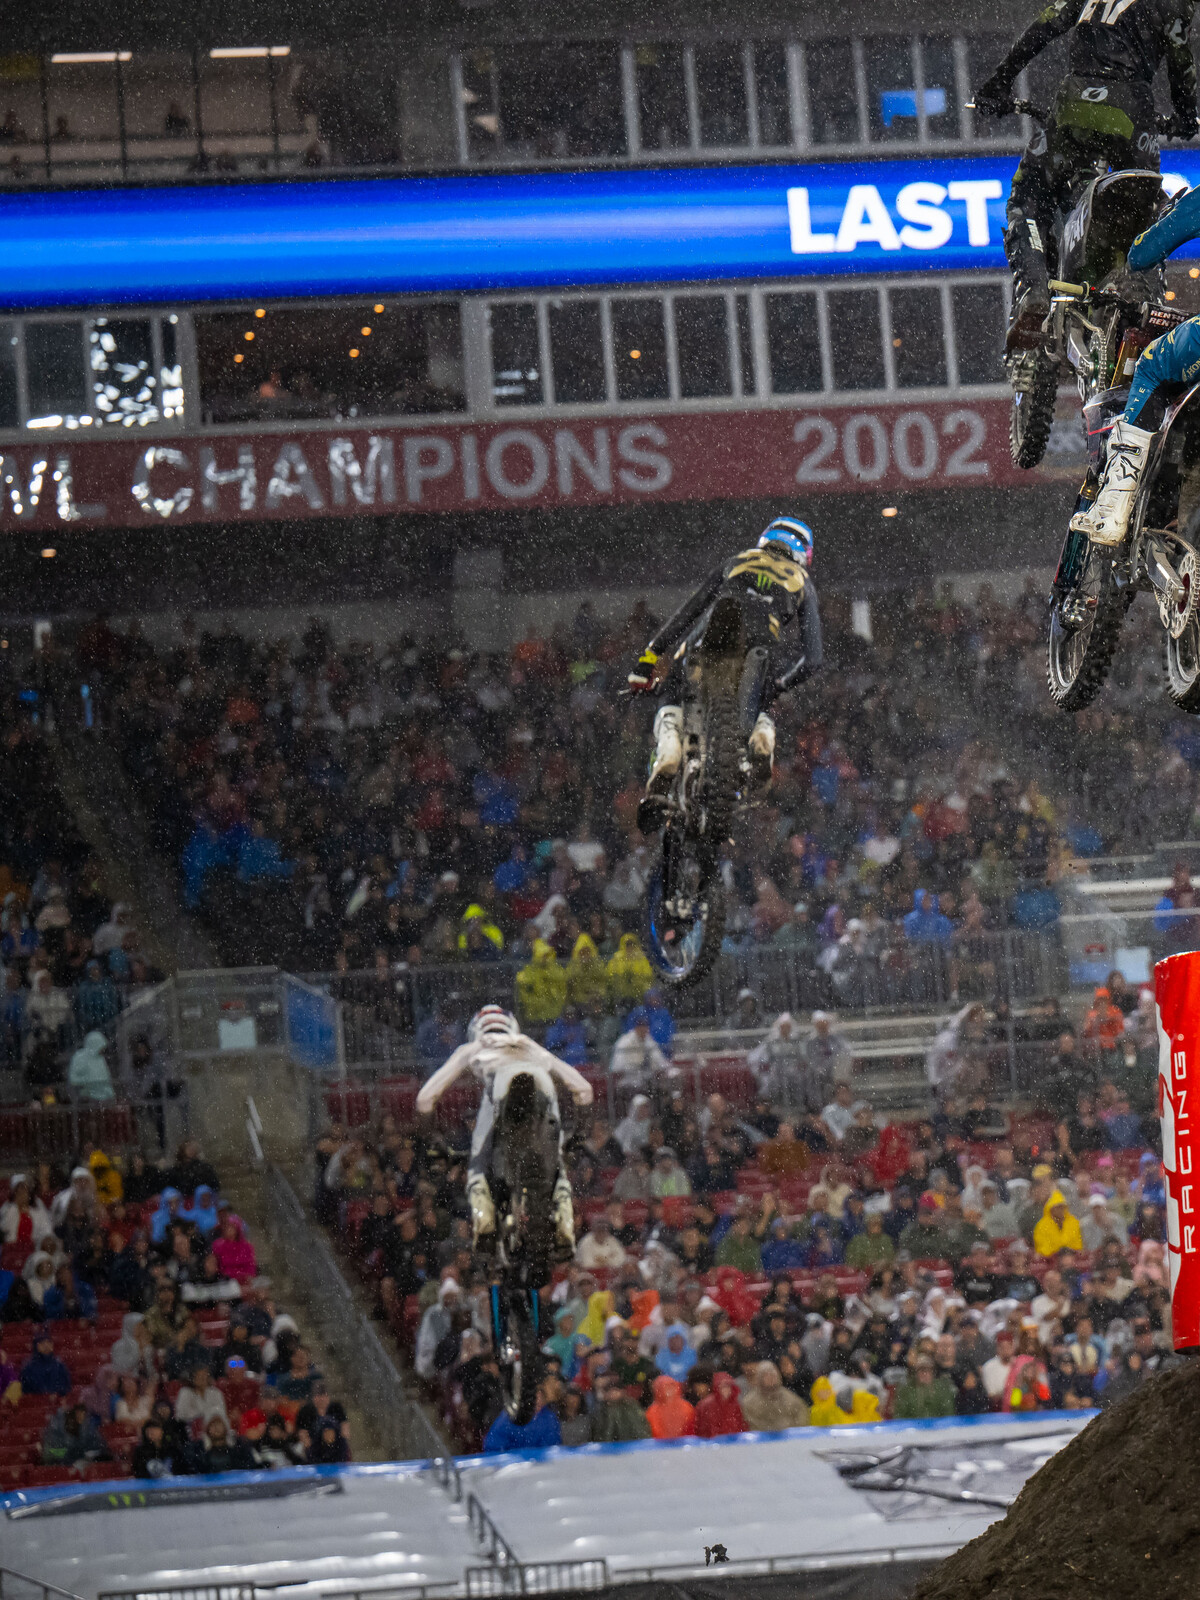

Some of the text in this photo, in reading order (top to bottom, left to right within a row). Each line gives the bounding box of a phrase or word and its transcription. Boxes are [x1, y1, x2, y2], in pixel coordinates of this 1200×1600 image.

[787, 180, 1002, 254] LAST
[1148, 317, 1180, 328] RENT
[1150, 309, 1187, 322] RENTH
[132, 423, 674, 517] CHAMPIONS
[793, 409, 989, 483] 2002
[1174, 1050, 1197, 1254] RACING
